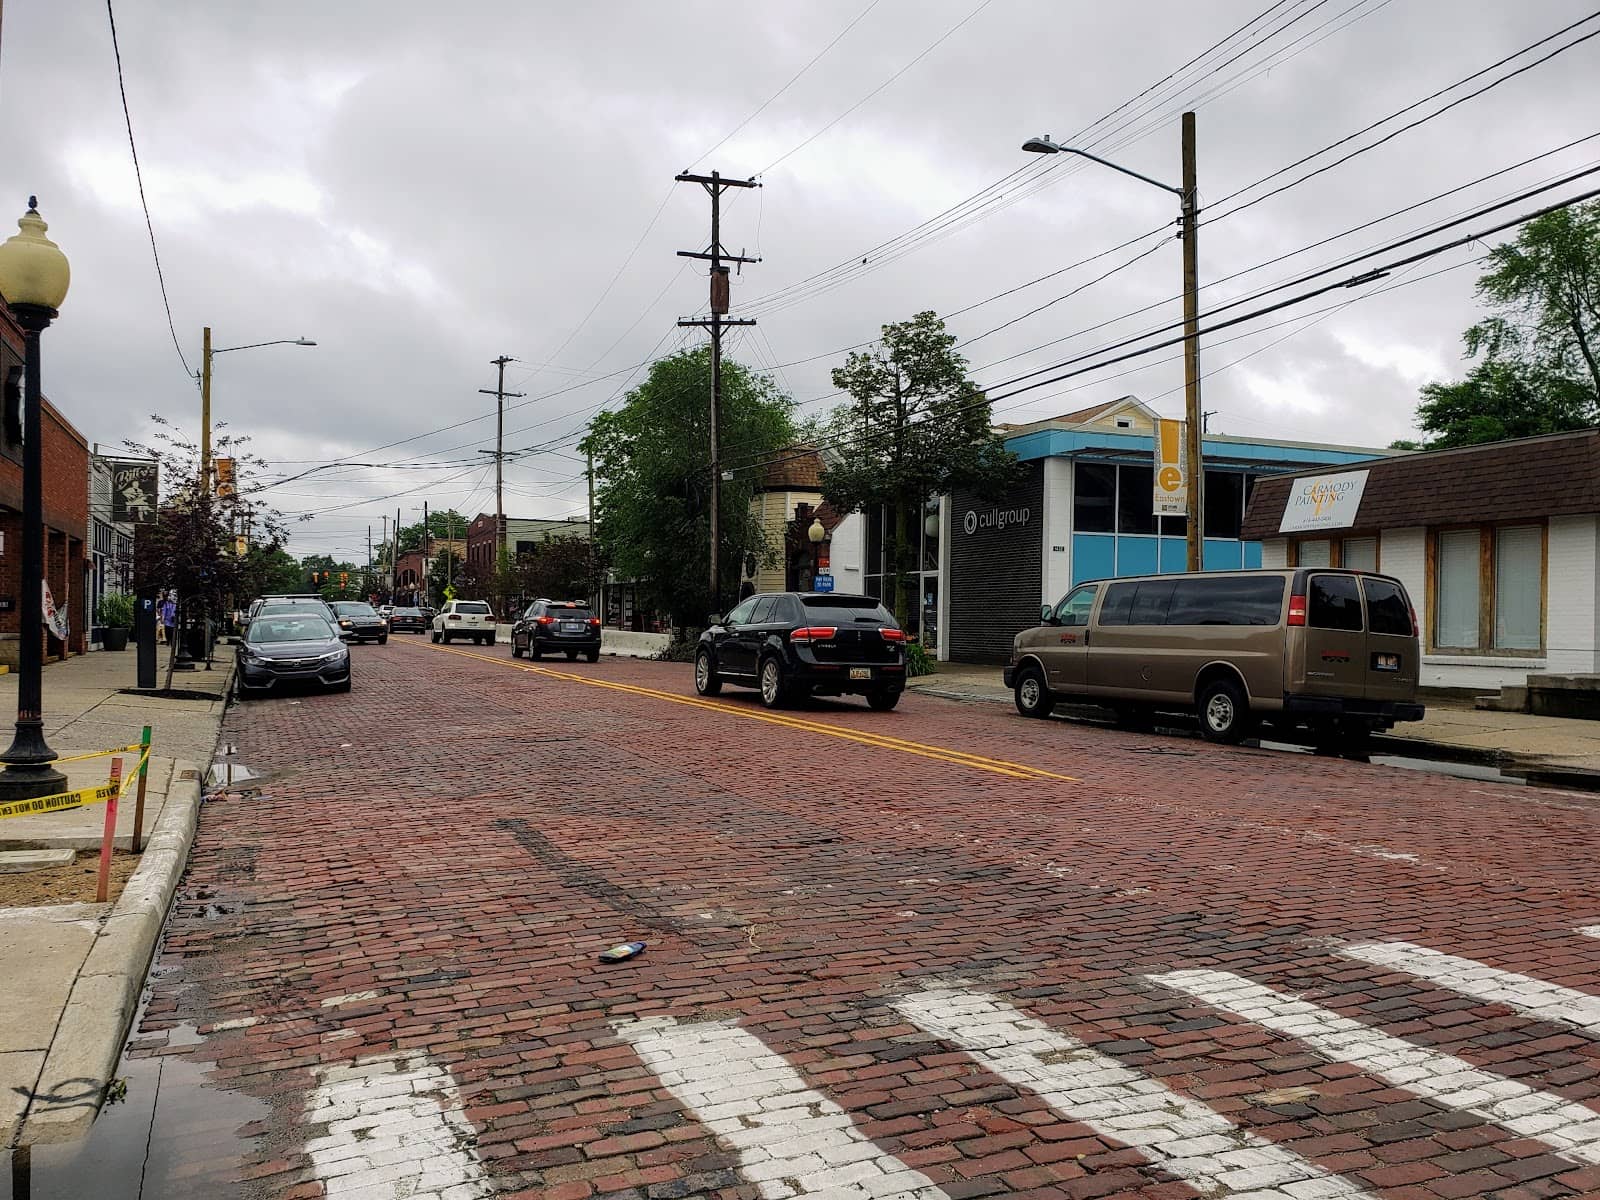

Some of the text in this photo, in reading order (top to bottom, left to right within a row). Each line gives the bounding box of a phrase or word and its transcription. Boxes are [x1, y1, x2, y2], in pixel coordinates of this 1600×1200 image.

[1303, 481, 1354, 495] CARMODY
[1295, 491, 1345, 506] PAINTING
[979, 507, 1030, 529] cullgroup
[144, 599, 151, 609] P
